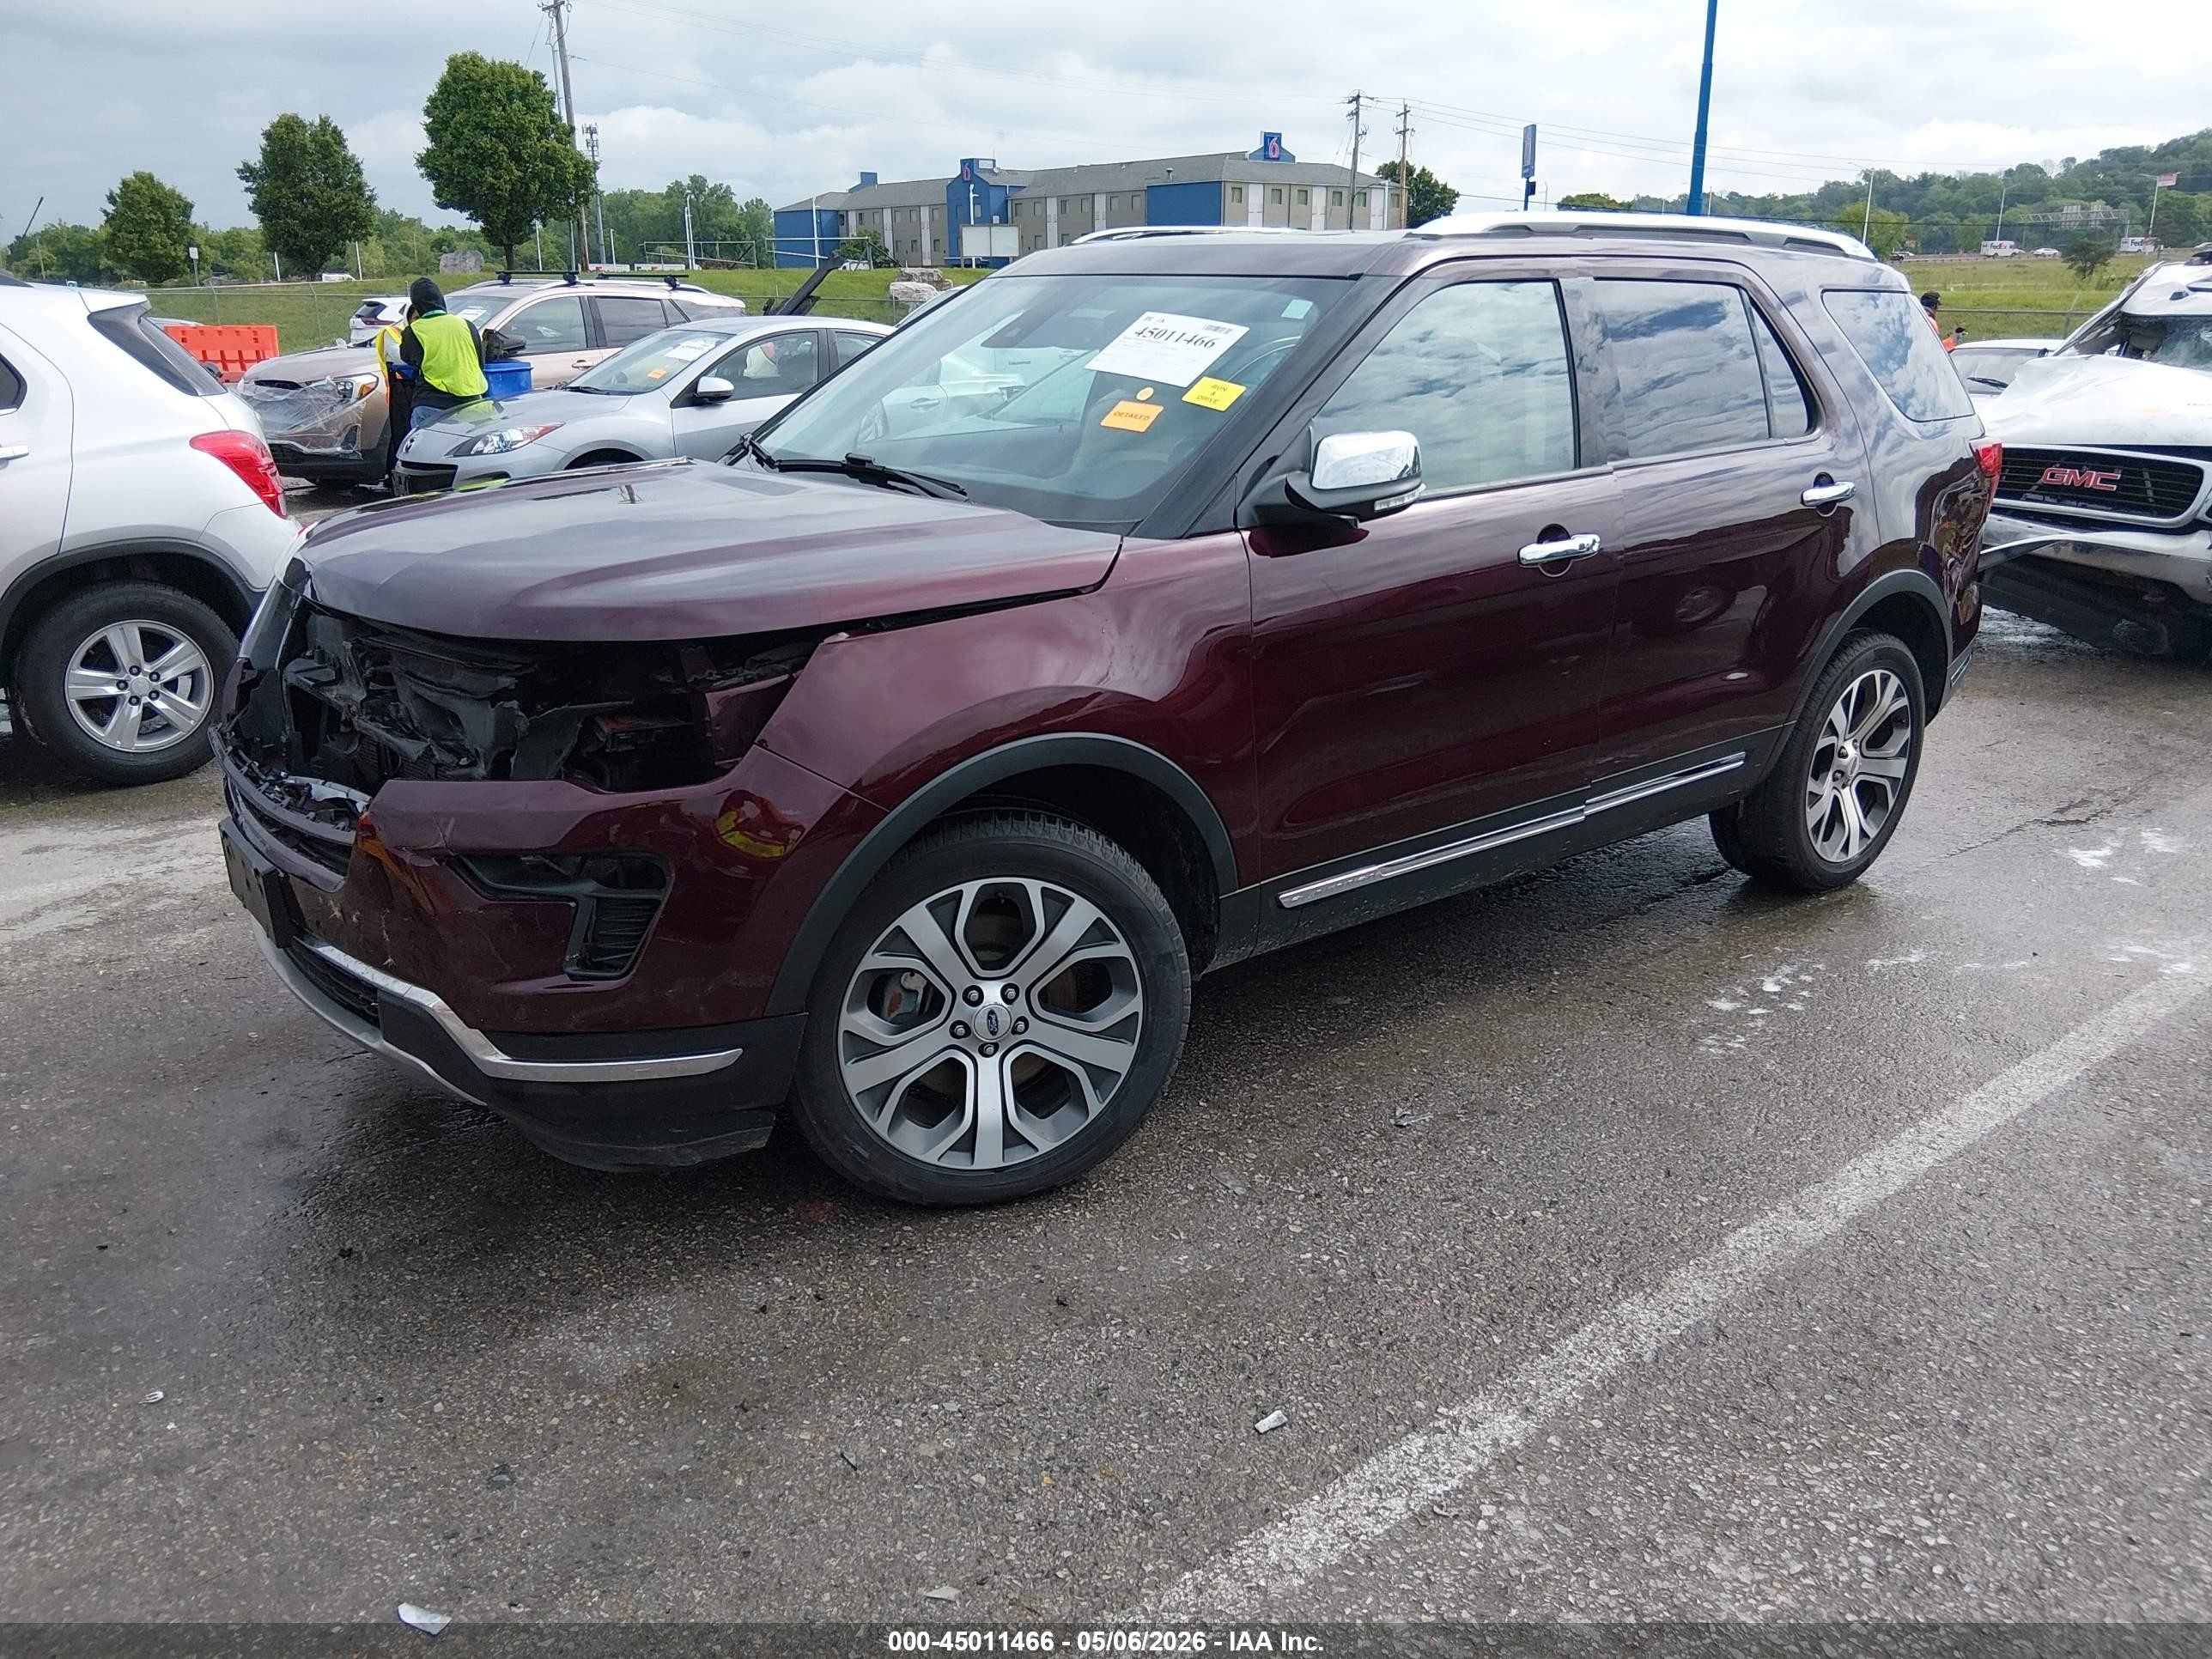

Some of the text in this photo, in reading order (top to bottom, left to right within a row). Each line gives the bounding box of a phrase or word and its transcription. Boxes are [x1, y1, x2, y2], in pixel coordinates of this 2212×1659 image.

[1268, 137, 1279, 159] 6
[1134, 326, 1222, 349] 45011466
[1211, 384, 1228, 392] RUN
[1196, 394, 1220, 404] DRIVE
[1114, 411, 1151, 422] DETAILED
[2042, 467, 2122, 491] GMC
[988, 1014, 998, 1032] Ford
